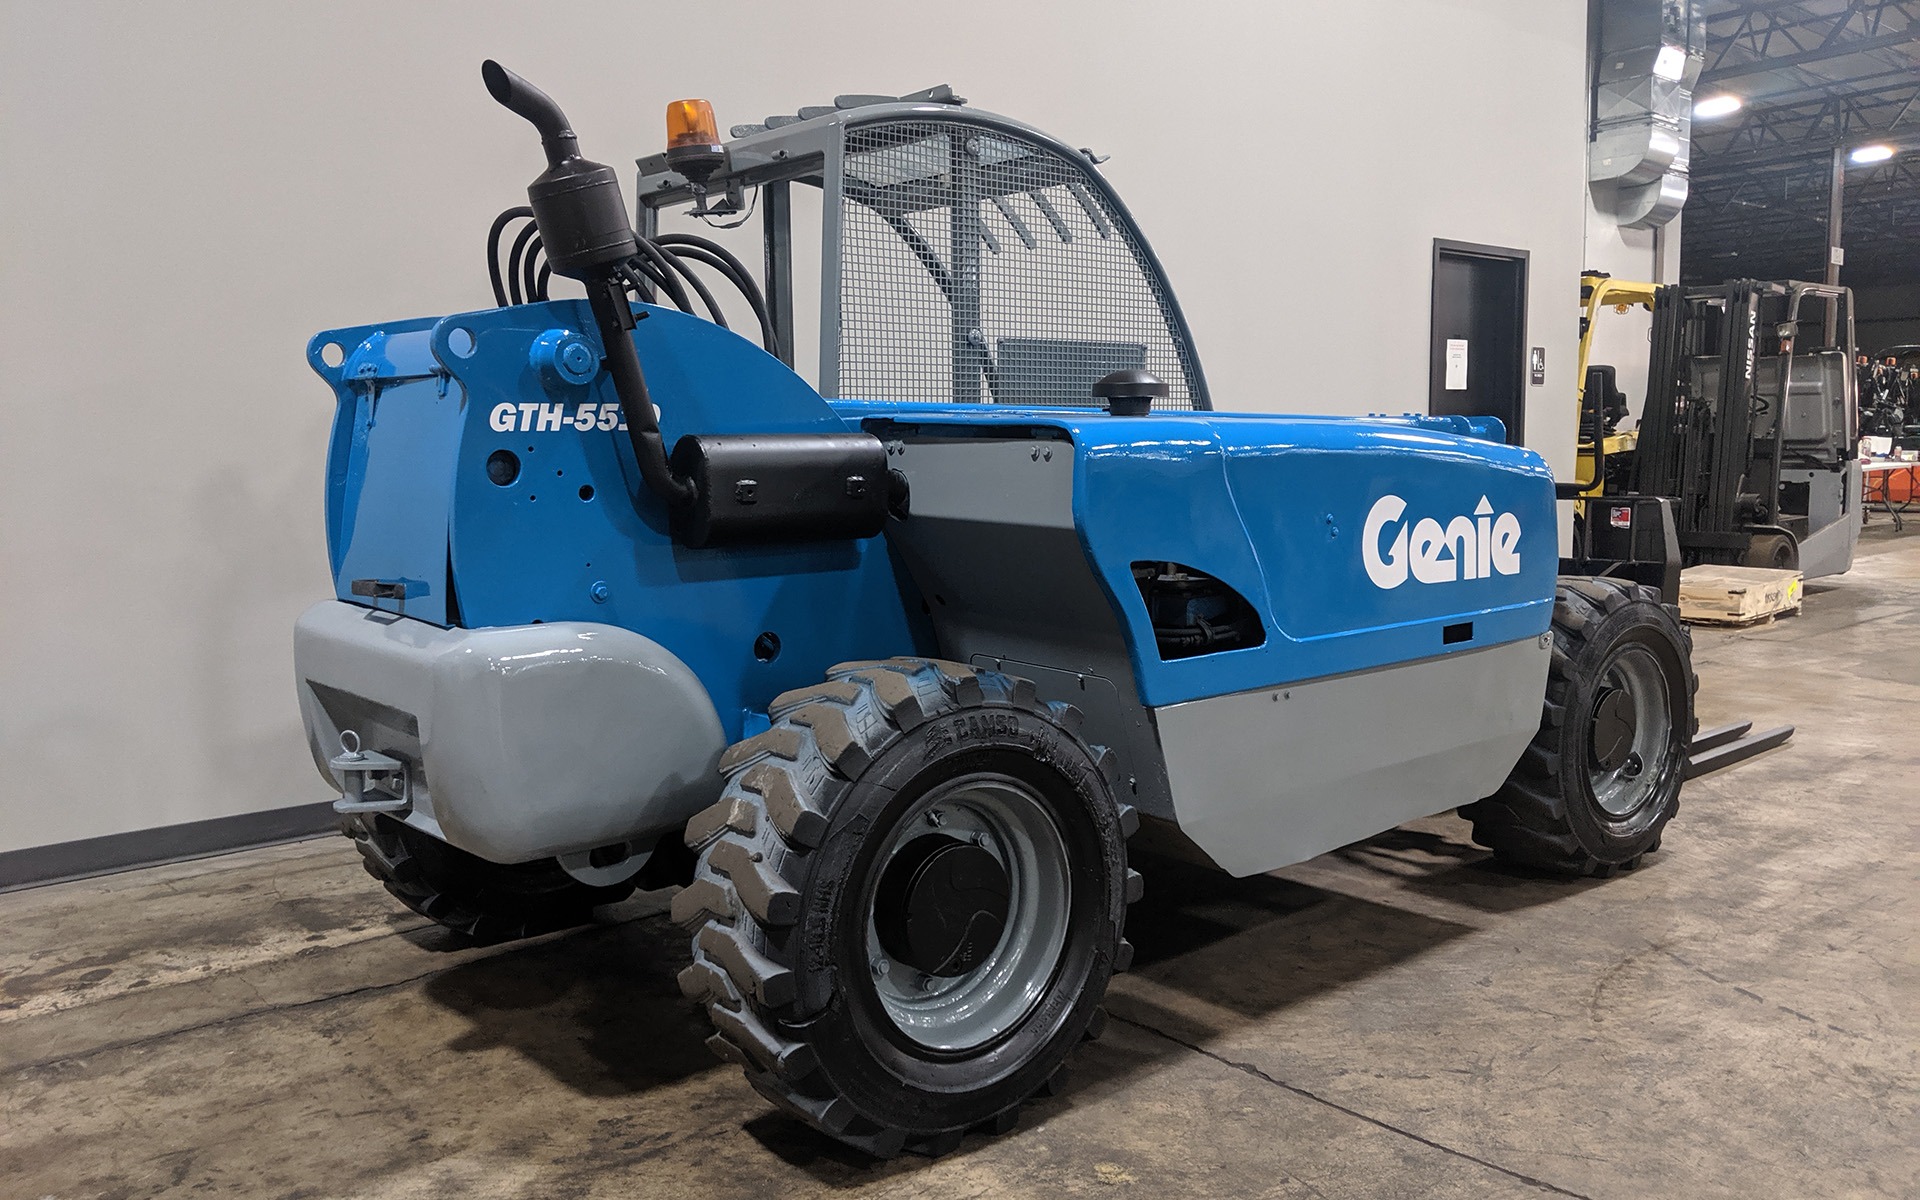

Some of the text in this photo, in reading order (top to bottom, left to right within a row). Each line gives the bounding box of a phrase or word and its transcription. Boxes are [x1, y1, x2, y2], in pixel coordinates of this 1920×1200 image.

[1745, 310, 1756, 379] NISSAN
[489, 402, 661, 432] GTH-55
[1362, 494, 1522, 590] Genie
